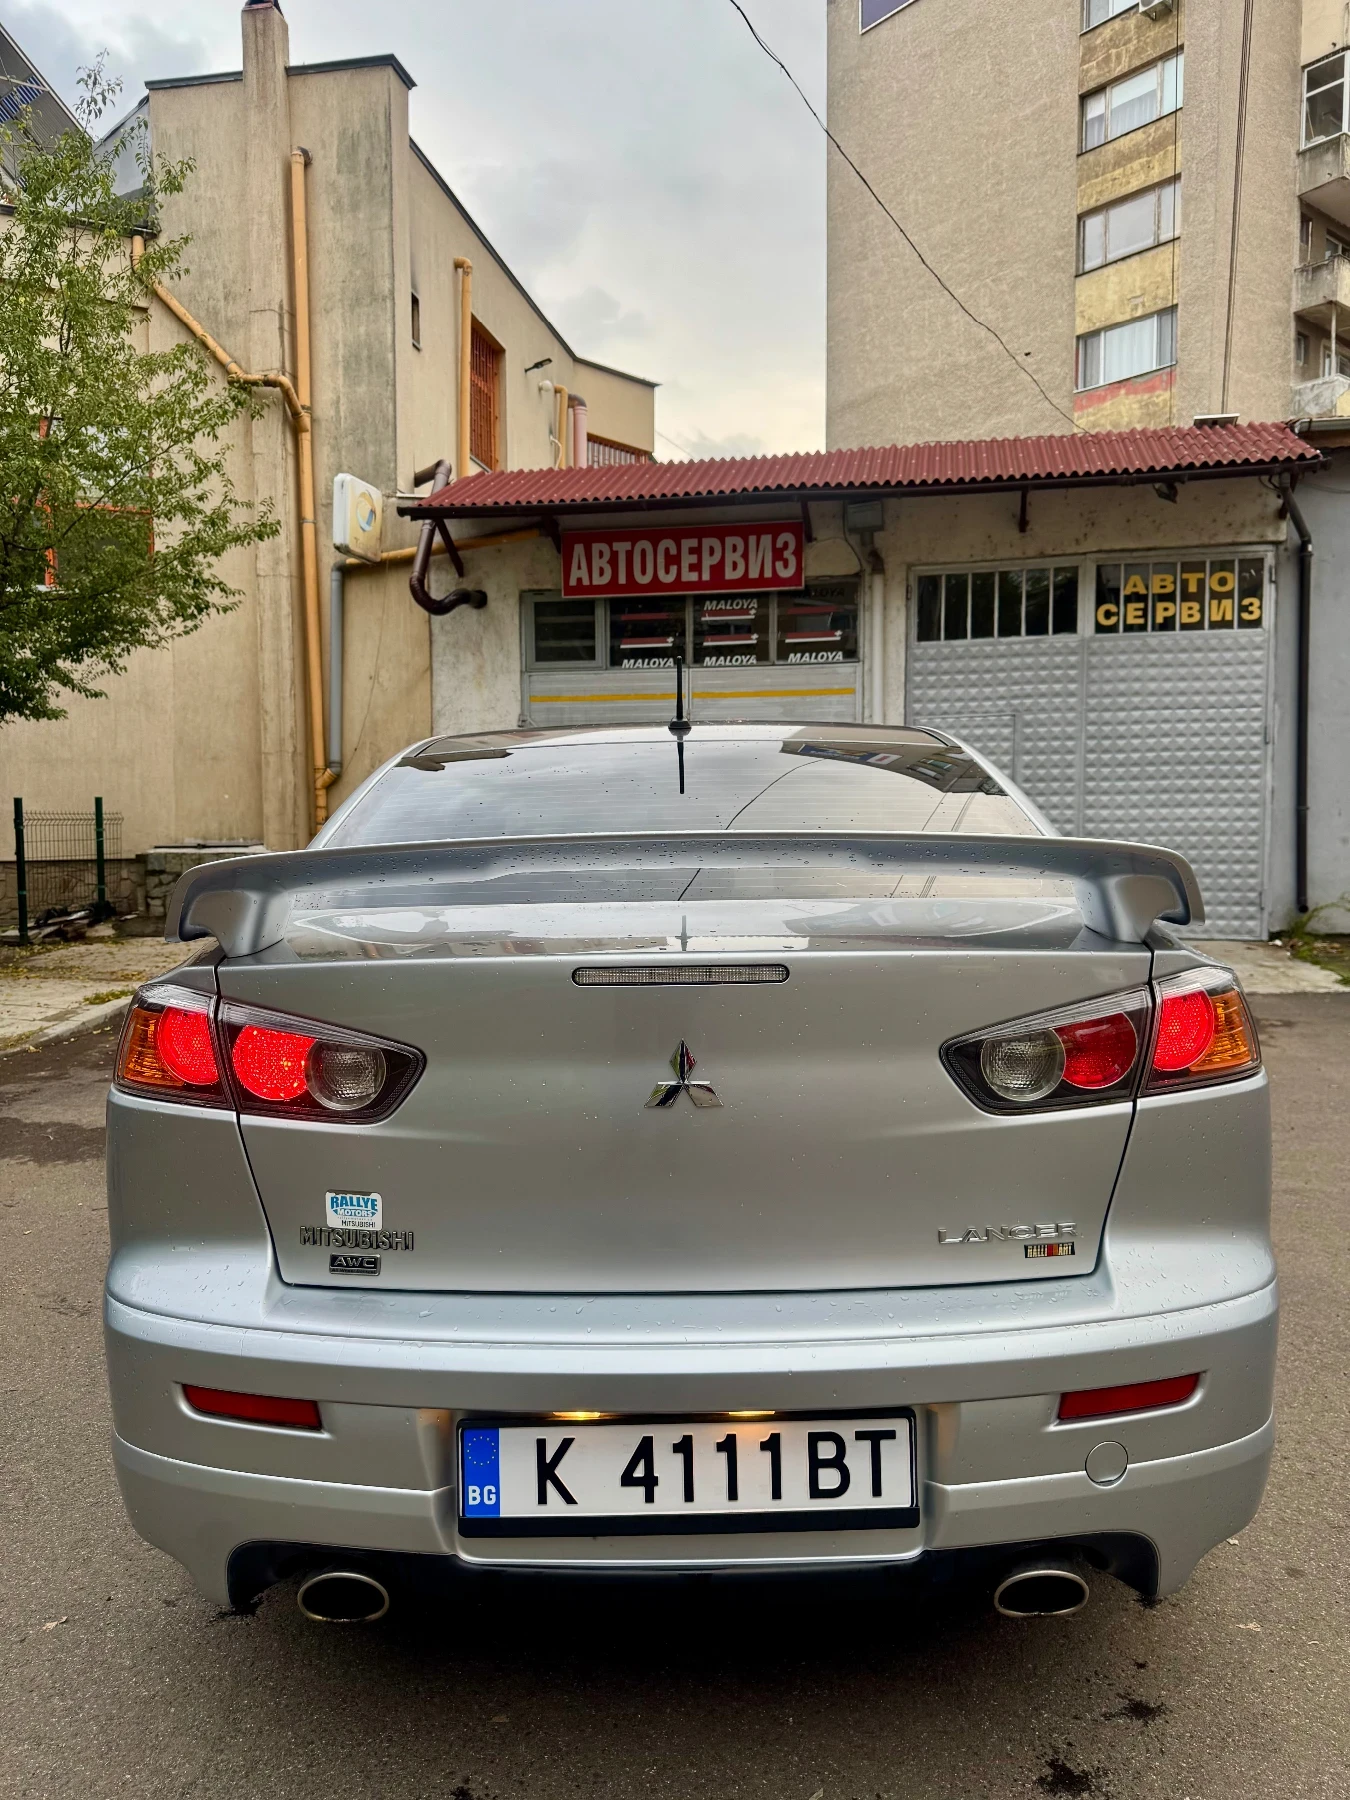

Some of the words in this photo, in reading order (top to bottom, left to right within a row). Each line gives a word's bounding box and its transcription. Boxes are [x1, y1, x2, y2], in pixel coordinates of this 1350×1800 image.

[569, 532, 797, 586] АВТОСЕРВИЗ
[1123, 571, 1235, 595] АВТО
[703, 598, 758, 611] MALOYA
[1096, 597, 1262, 626] СЕРВИЗ
[621, 657, 674, 669] MALOYA
[703, 654, 758, 667] MALOYA
[787, 651, 844, 664] MALOYA
[330, 1195, 378, 1212] RALLYE
[338, 1208, 373, 1217] MOTORS
[341, 1219, 376, 1228] MITSUBISHI
[300, 1226, 414, 1251] MITSUBISHI
[938, 1222, 1077, 1244] LANCER
[333, 1256, 375, 1267] AWC
[536, 1437, 578, 1505] K
[468, 1485, 497, 1505] BG
